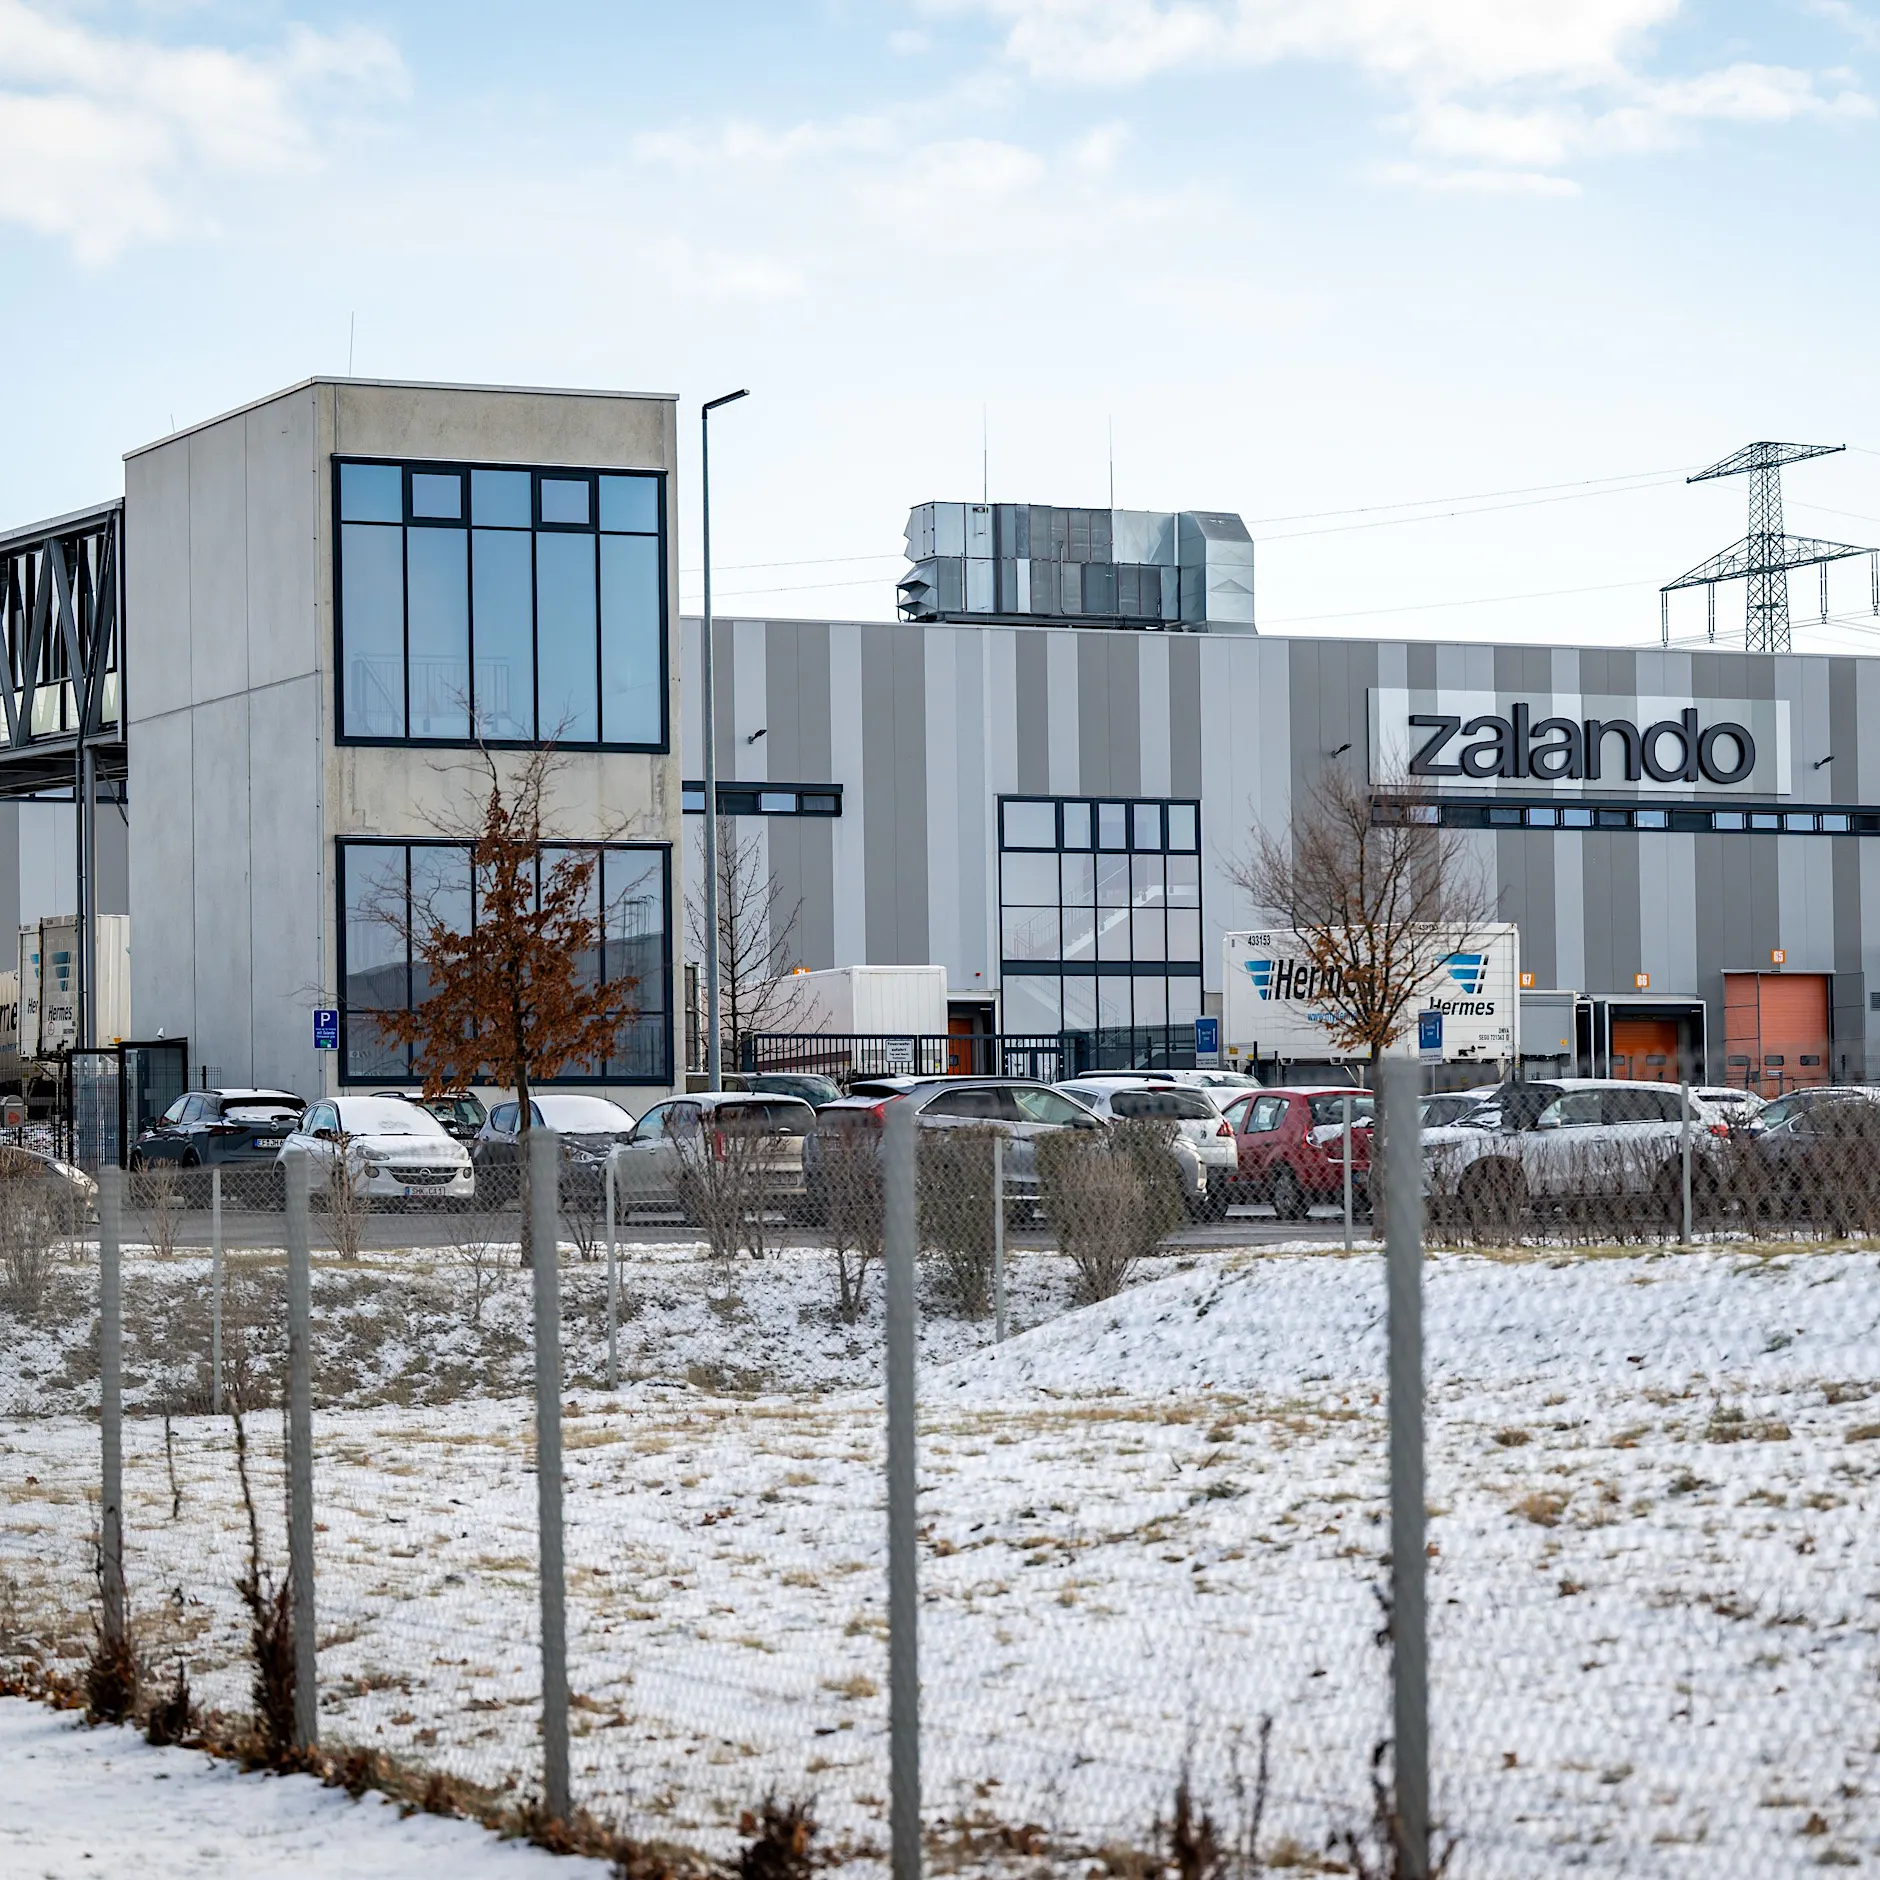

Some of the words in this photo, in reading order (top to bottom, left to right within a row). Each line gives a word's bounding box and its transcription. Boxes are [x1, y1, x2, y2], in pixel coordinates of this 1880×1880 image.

[1409, 702, 1756, 784] zalando
[1247, 934, 1271, 946] 433153
[1274, 958, 1360, 1001] Herm
[1522, 973, 1532, 985] 67
[48, 1004, 73, 1021] Hermes
[1429, 996, 1495, 1016] Hermes
[320, 1012, 331, 1027] P
